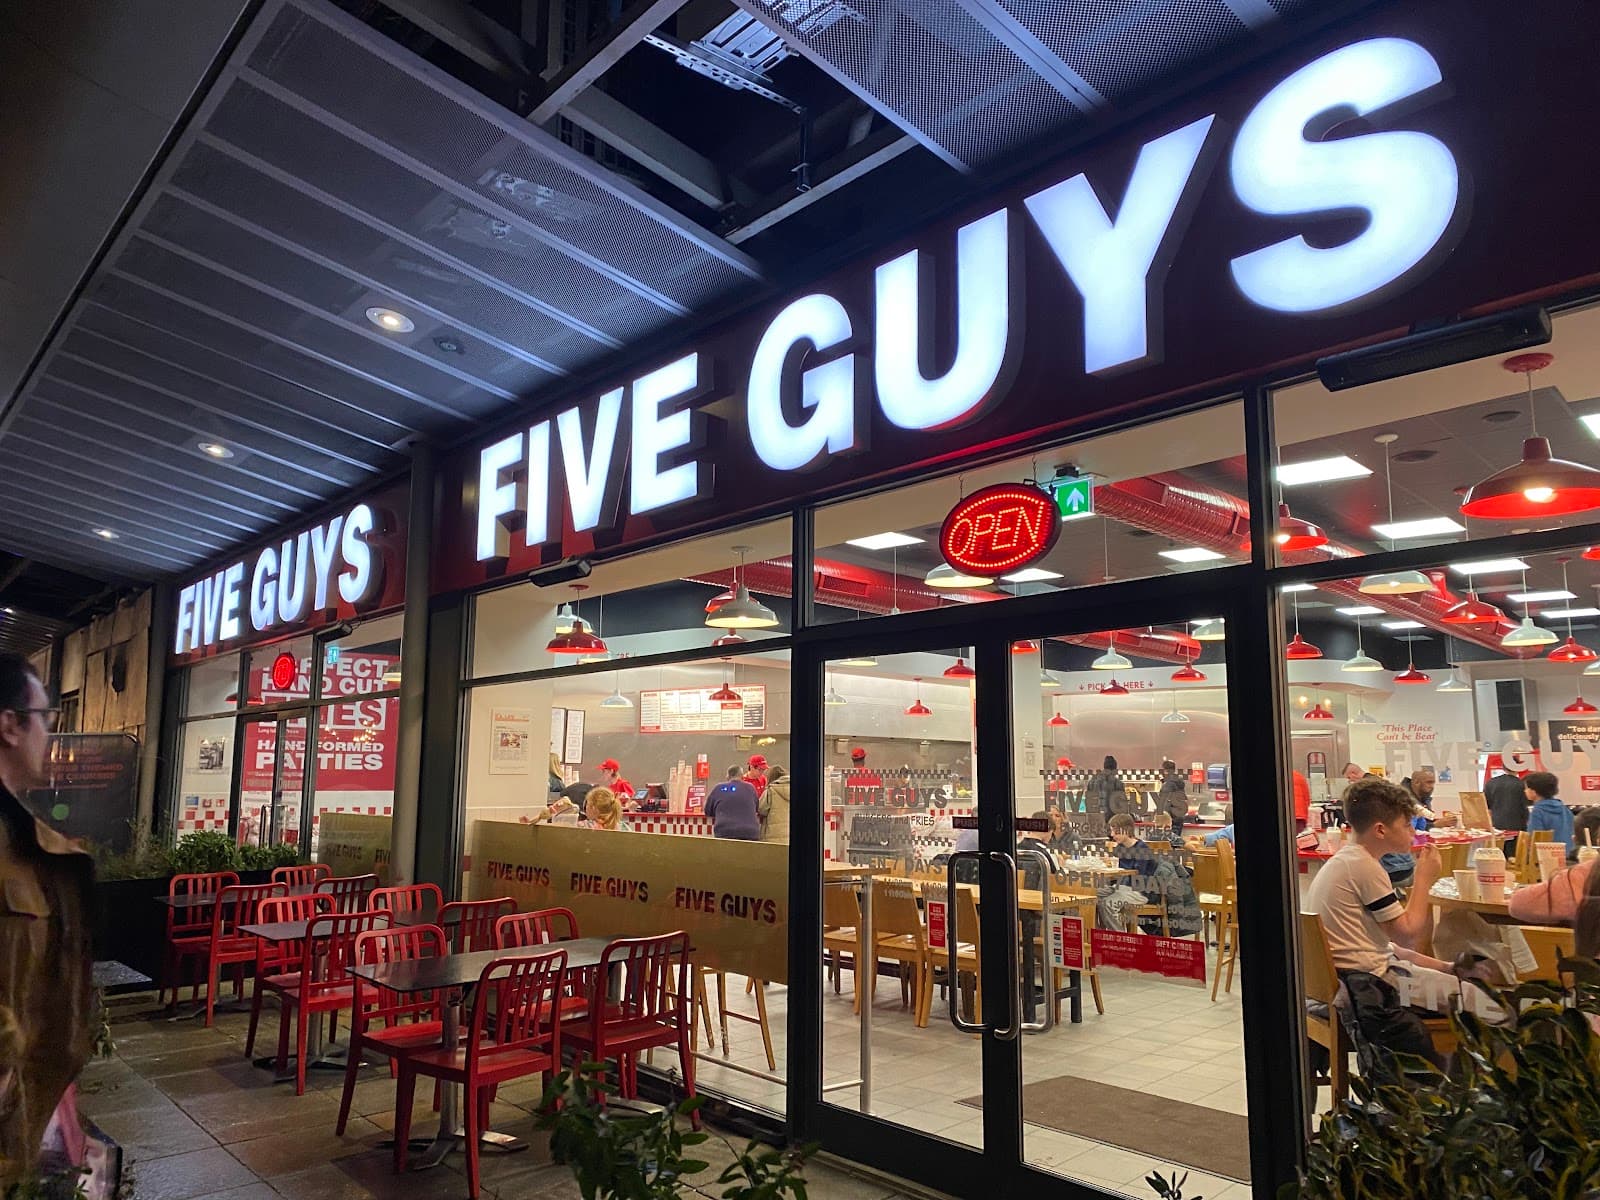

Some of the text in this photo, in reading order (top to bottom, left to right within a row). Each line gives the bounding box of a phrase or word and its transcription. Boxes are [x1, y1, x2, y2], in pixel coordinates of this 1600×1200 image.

[477, 37, 1459, 562] FIVE GUYS
[948, 501, 1045, 558] OPEN
[175, 504, 373, 654] FIVE GUYS
[339, 677, 388, 694] CUT
[1123, 681, 1145, 689] HERE
[1407, 723, 1432, 732] Place
[256, 752, 383, 770] PATTIES
[1384, 741, 1484, 773] FIVE
[844, 785, 948, 809] FIVE GUYS
[1045, 790, 1188, 818] FIVE GUYS
[911, 816, 935, 826] FRIES
[1060, 822, 1107, 836] BURGER
[487, 861, 550, 888] FIVE GUYS
[570, 872, 649, 903] FIVE GUYS
[675, 887, 776, 924] FIVE GUYS
